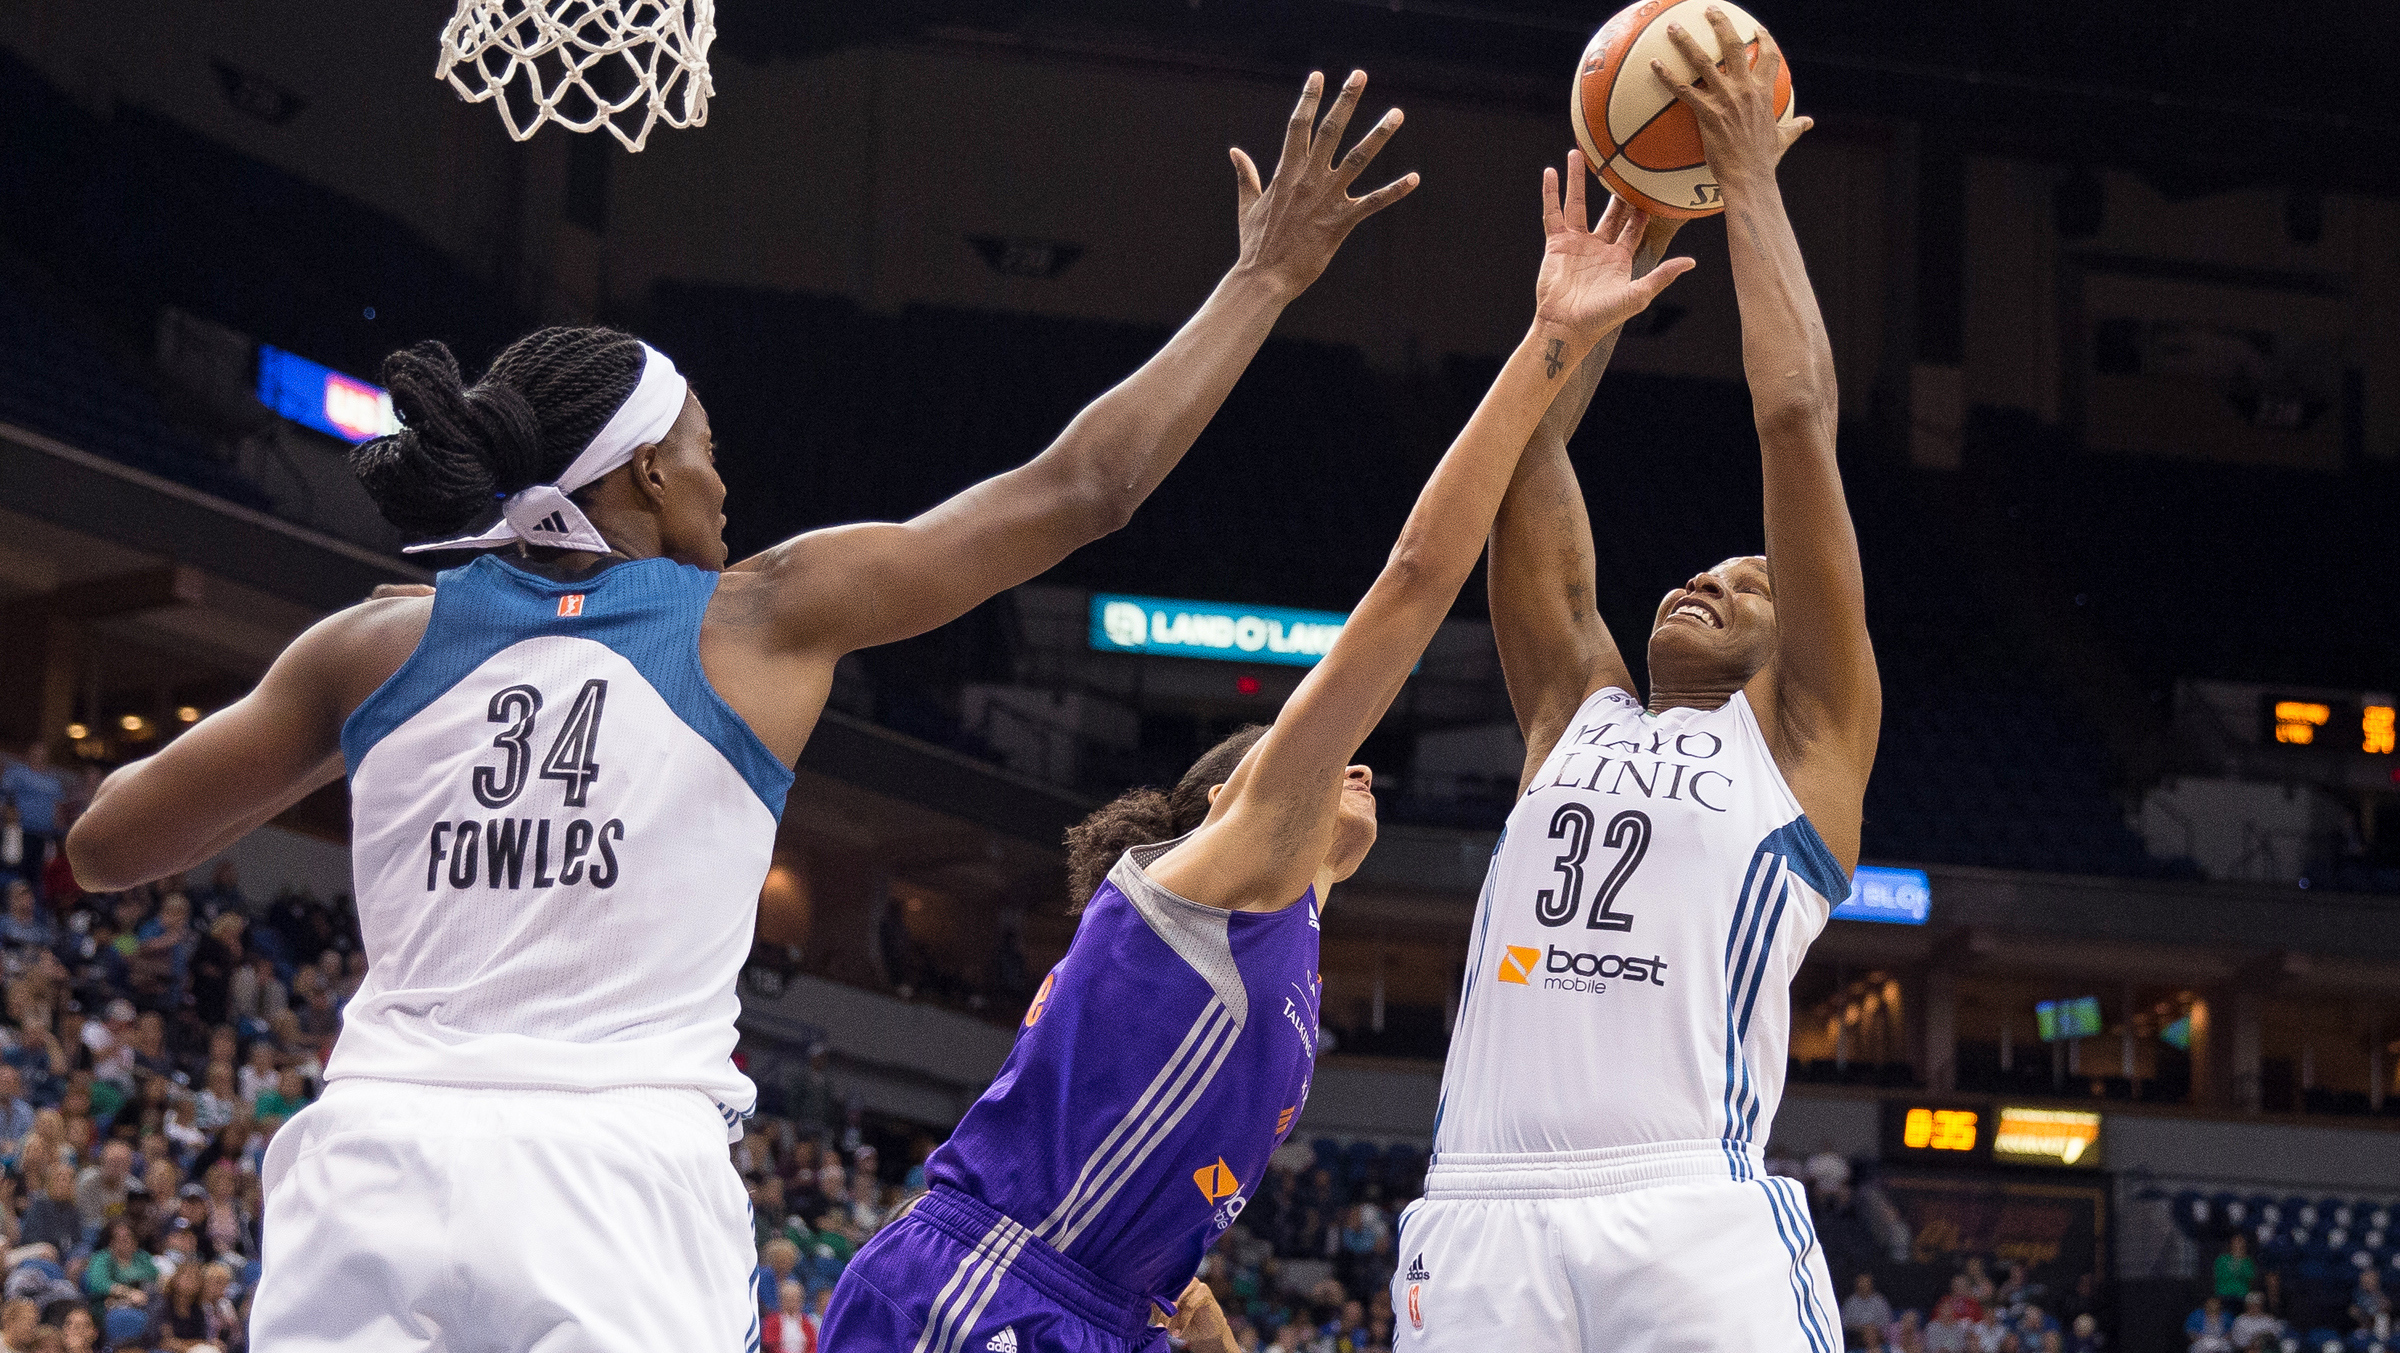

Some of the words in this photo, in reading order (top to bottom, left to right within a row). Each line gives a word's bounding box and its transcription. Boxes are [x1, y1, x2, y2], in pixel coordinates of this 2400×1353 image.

[472, 679, 608, 809] 34
[1535, 802, 1652, 932] 32
[1544, 977, 1606, 994] mobile
[1546, 944, 1668, 987] boost
[1283, 997, 1313, 1059] TALKING
